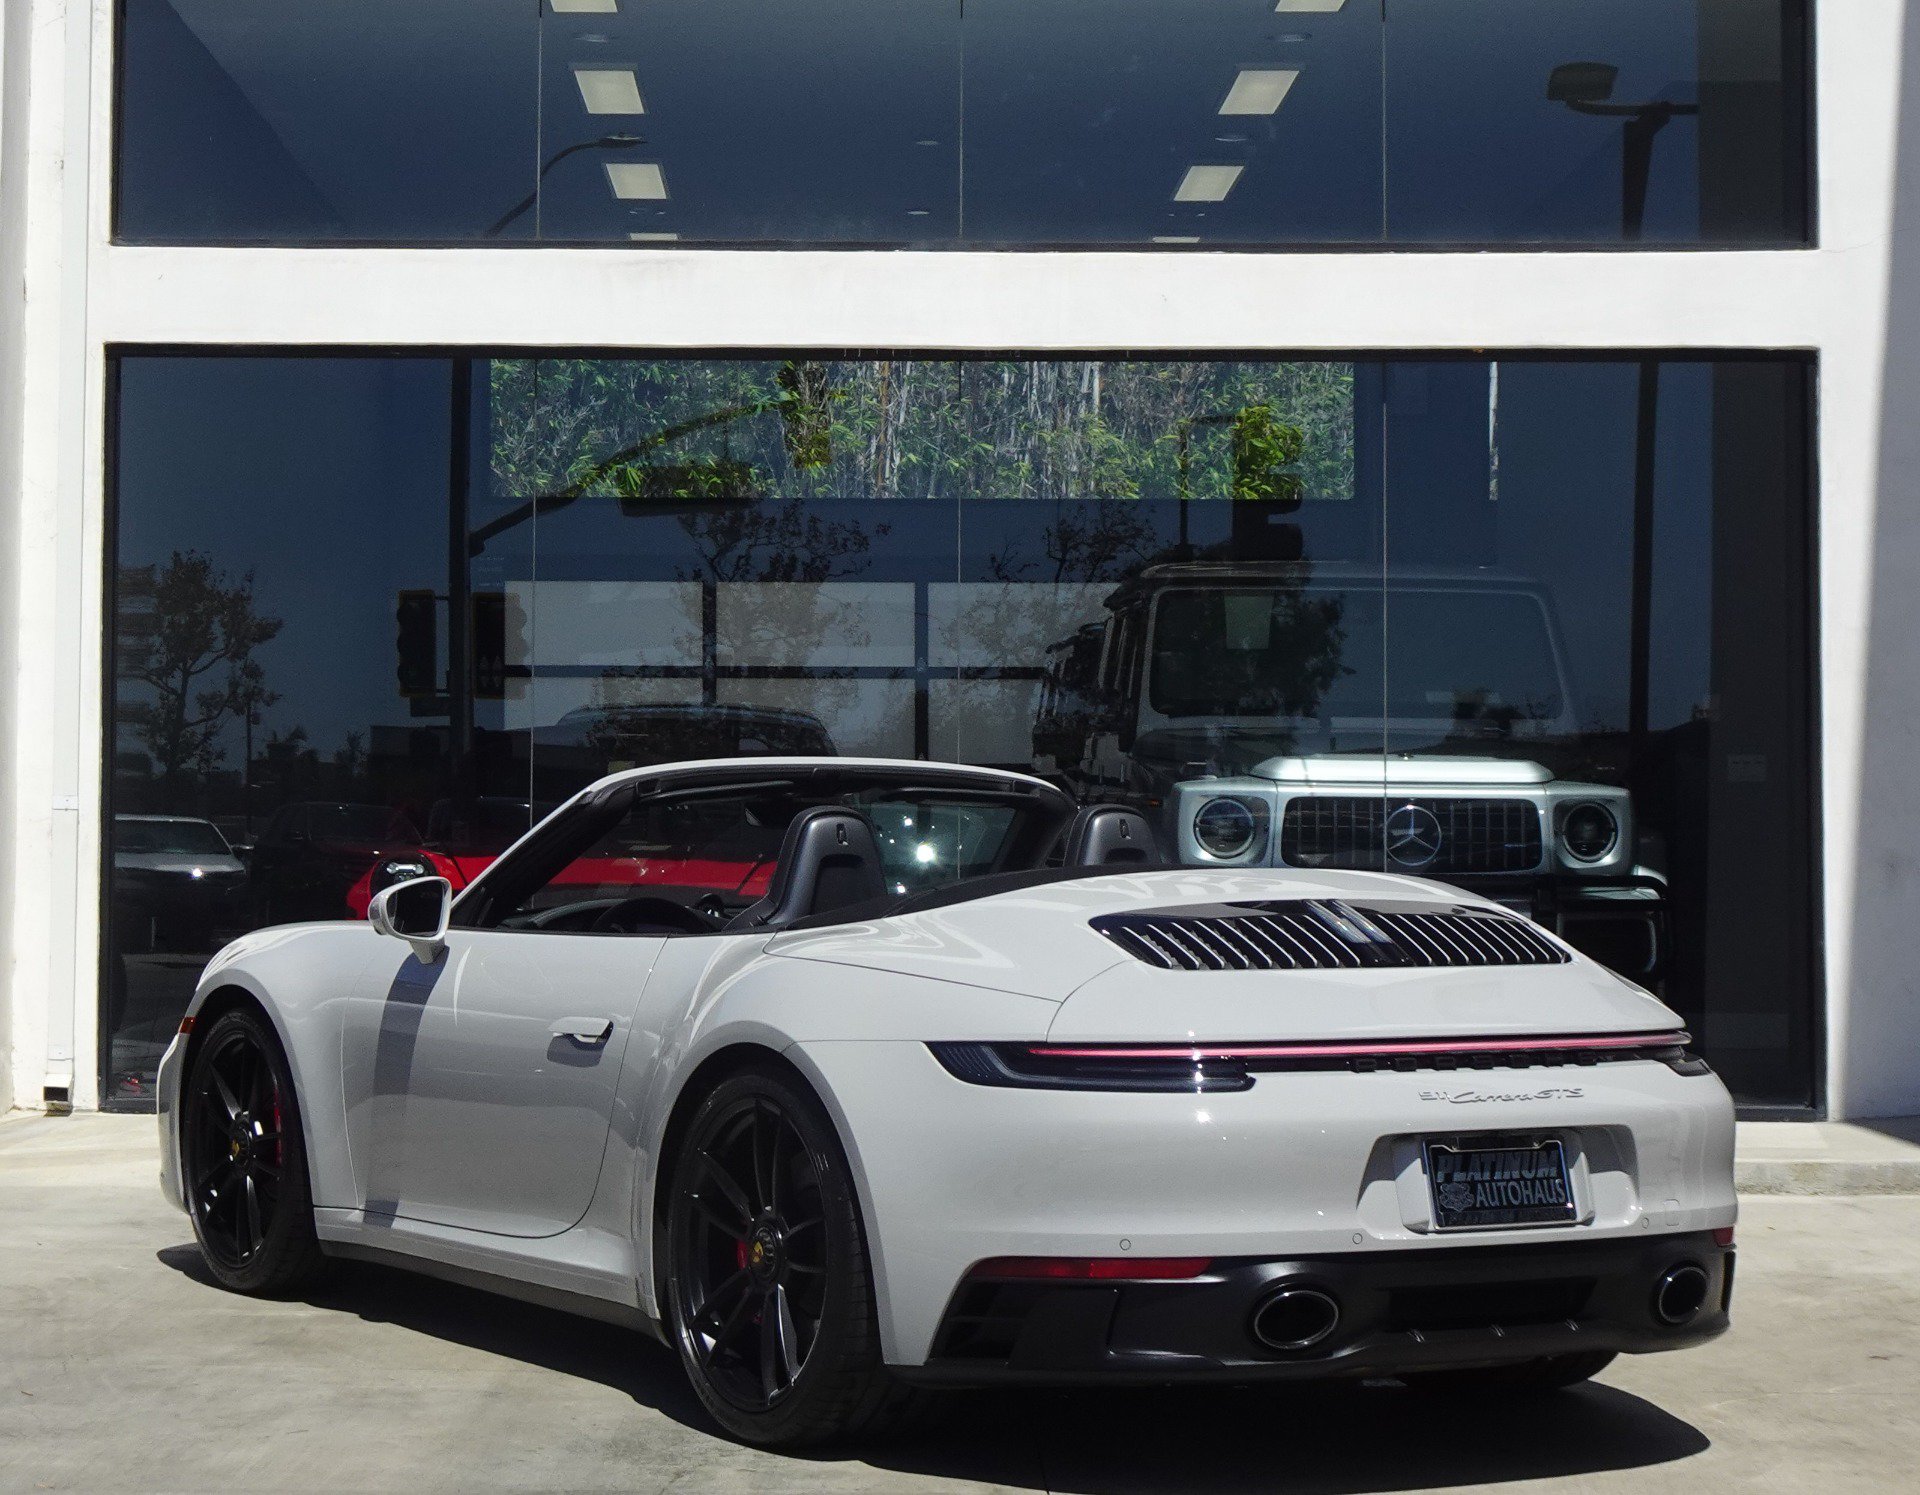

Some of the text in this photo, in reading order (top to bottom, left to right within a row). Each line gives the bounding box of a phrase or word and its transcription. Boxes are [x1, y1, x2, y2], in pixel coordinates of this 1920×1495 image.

[1449, 1091, 1534, 1104] Carrera
[1534, 1088, 1584, 1100] GTS
[1436, 1150, 1558, 1182] PLATINUM
[1475, 1178, 1566, 1208] AUTOHAUS
